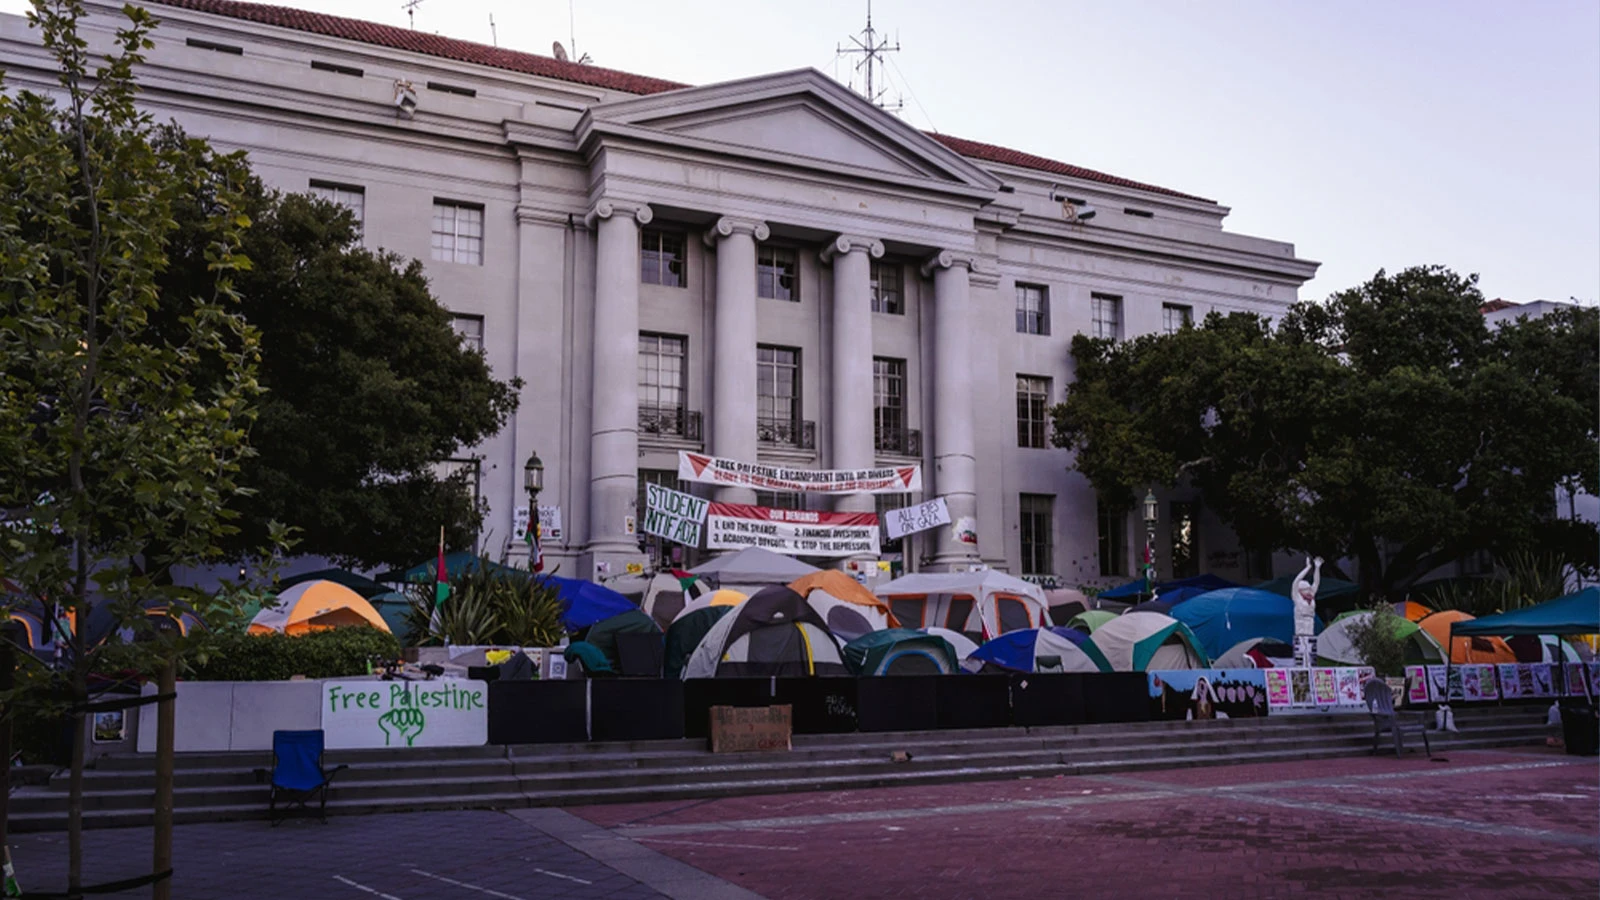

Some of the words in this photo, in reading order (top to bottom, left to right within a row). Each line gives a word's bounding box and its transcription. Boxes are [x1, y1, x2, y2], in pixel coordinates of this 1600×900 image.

[715, 459, 735, 471] FREE
[737, 462, 778, 479] PALESTINE
[648, 485, 707, 520] STUDENT
[898, 508, 915, 523] ALL
[920, 501, 939, 517] EYES
[722, 521, 735, 530] END
[737, 522, 749, 532] THE
[785, 510, 819, 522] DEMANDS
[901, 522, 915, 533] ON
[917, 511, 941, 529] GAZA
[802, 540, 818, 550] STOP
[820, 541, 831, 551] THE
[329, 686, 380, 712] Free
[389, 683, 485, 711] Palestine
